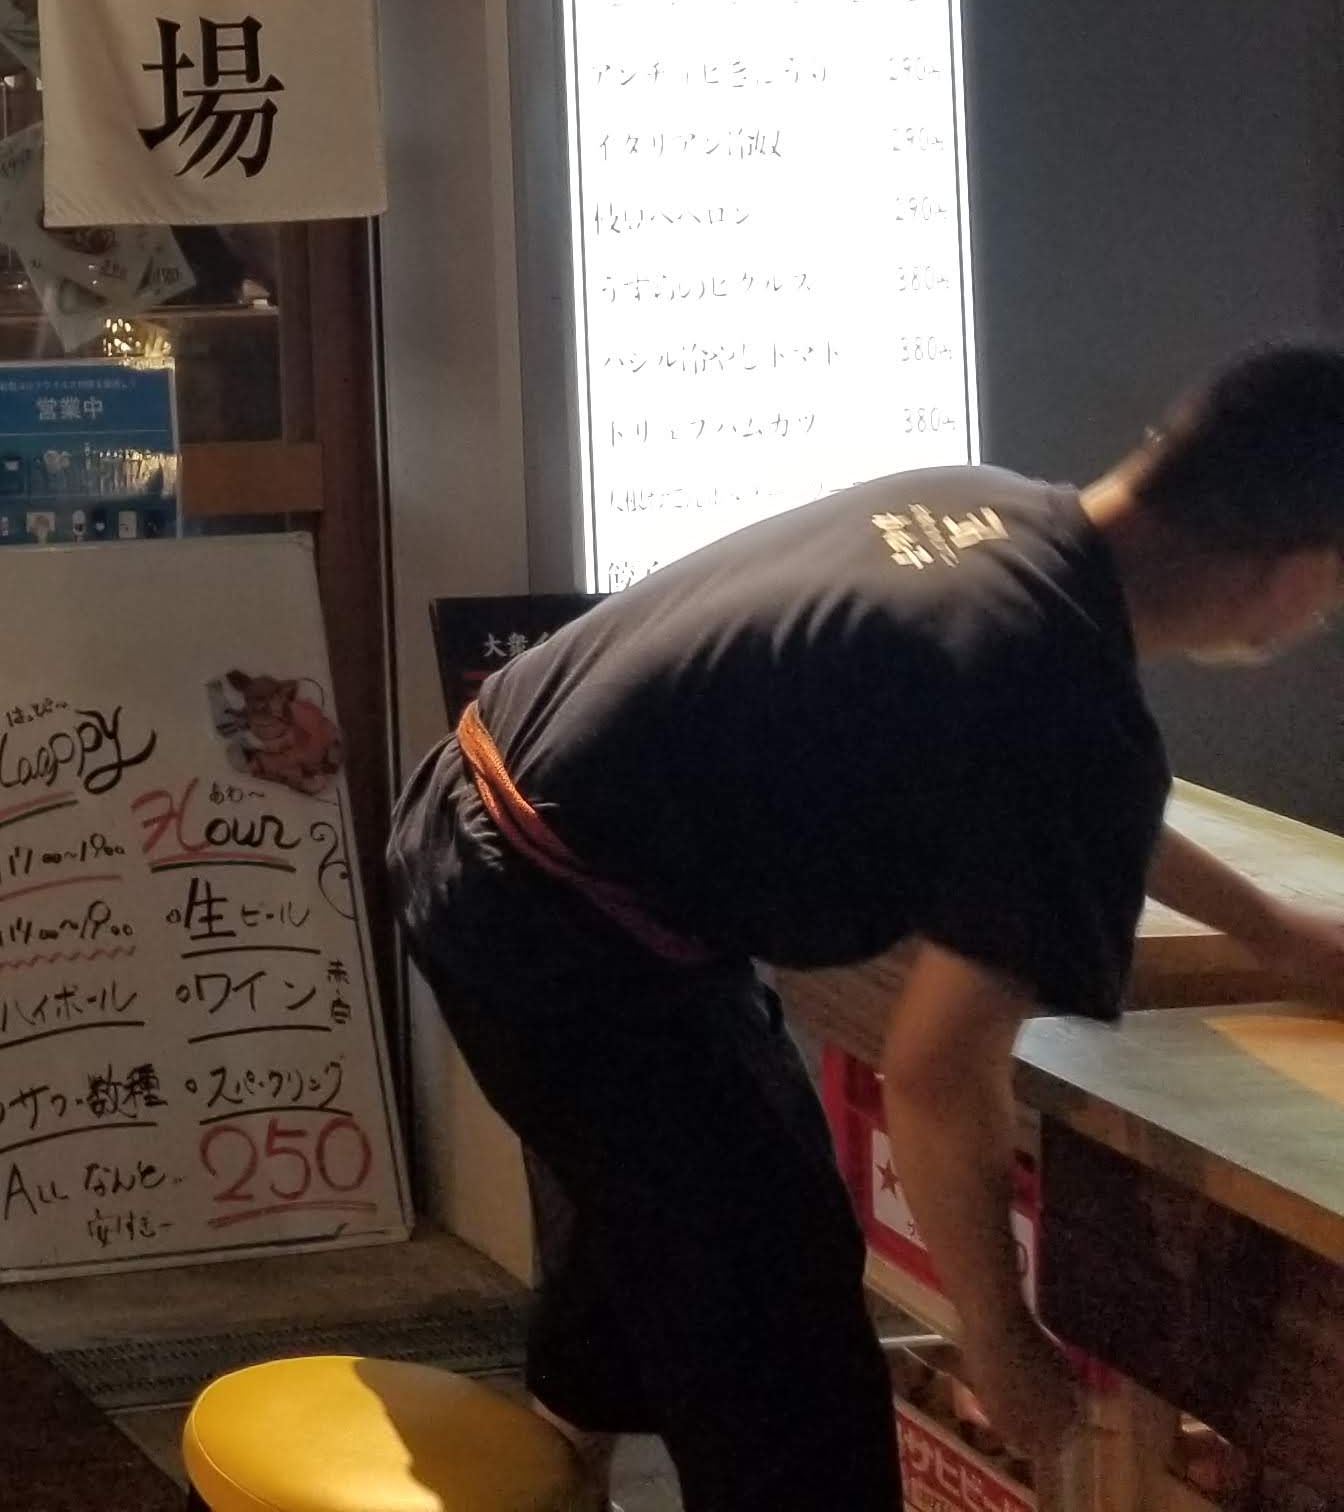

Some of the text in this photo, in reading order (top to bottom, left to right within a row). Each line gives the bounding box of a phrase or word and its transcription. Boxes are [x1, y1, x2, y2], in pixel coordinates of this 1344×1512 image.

[37, 395, 105, 421] 営業中
[198, 1117, 374, 1204] 250
